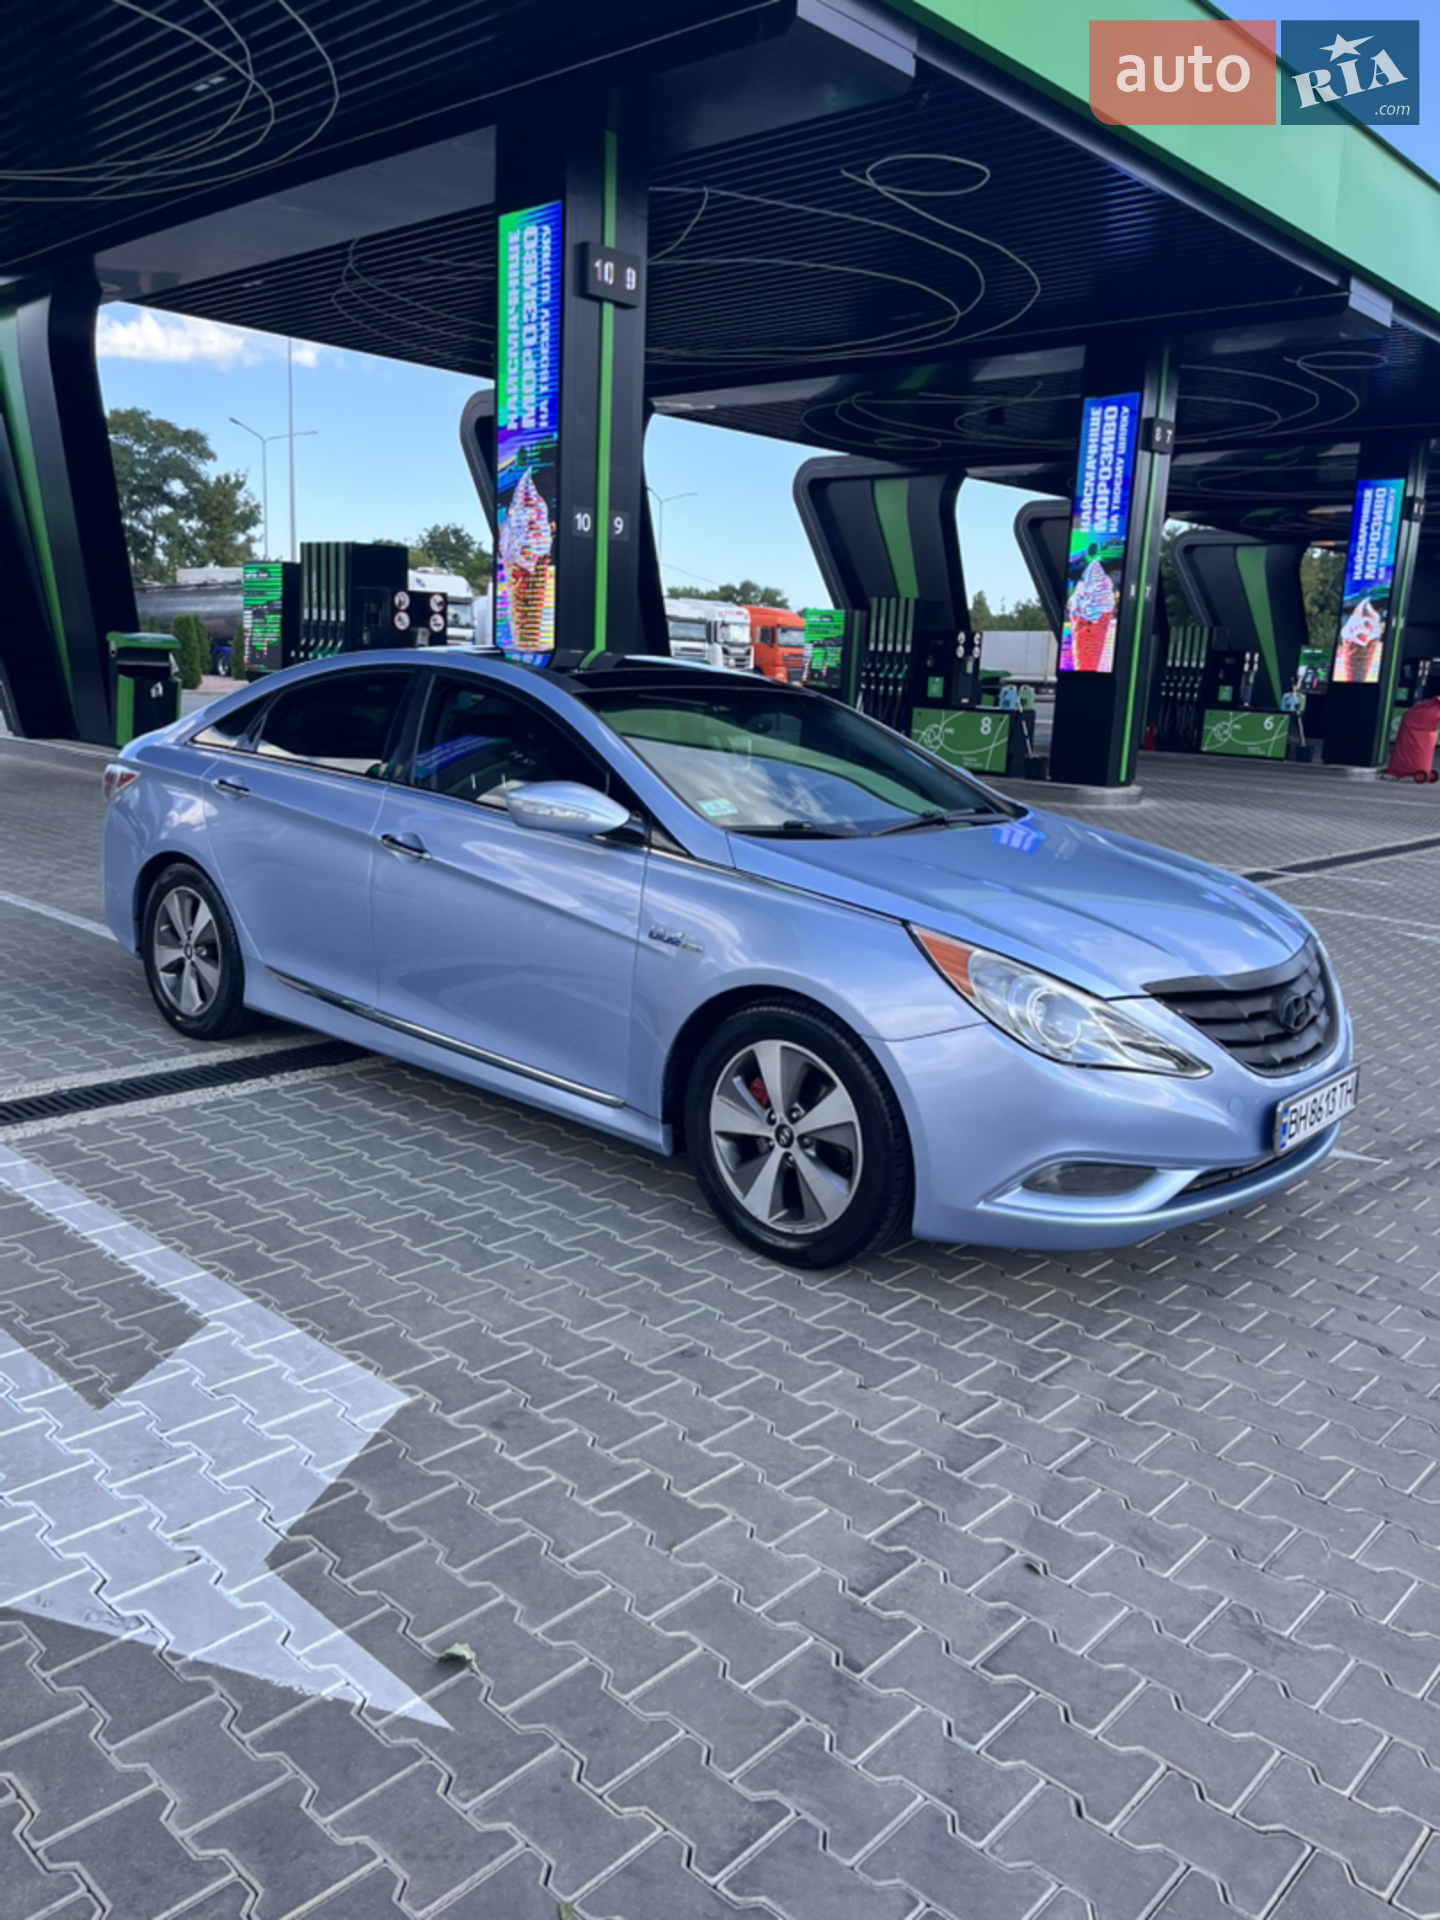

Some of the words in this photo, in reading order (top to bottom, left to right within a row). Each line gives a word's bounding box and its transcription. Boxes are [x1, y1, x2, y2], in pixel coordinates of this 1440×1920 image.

[594, 259, 614, 285] 10
[522, 225, 538, 429] МОРОЗИВО
[539, 399, 549, 428] НА
[1094, 405, 1118, 533] МОРОЗИВО
[574, 512, 591, 532] 10
[614, 516, 624, 535] 9
[980, 716, 992, 736] 8
[1263, 716, 1274, 731] 6
